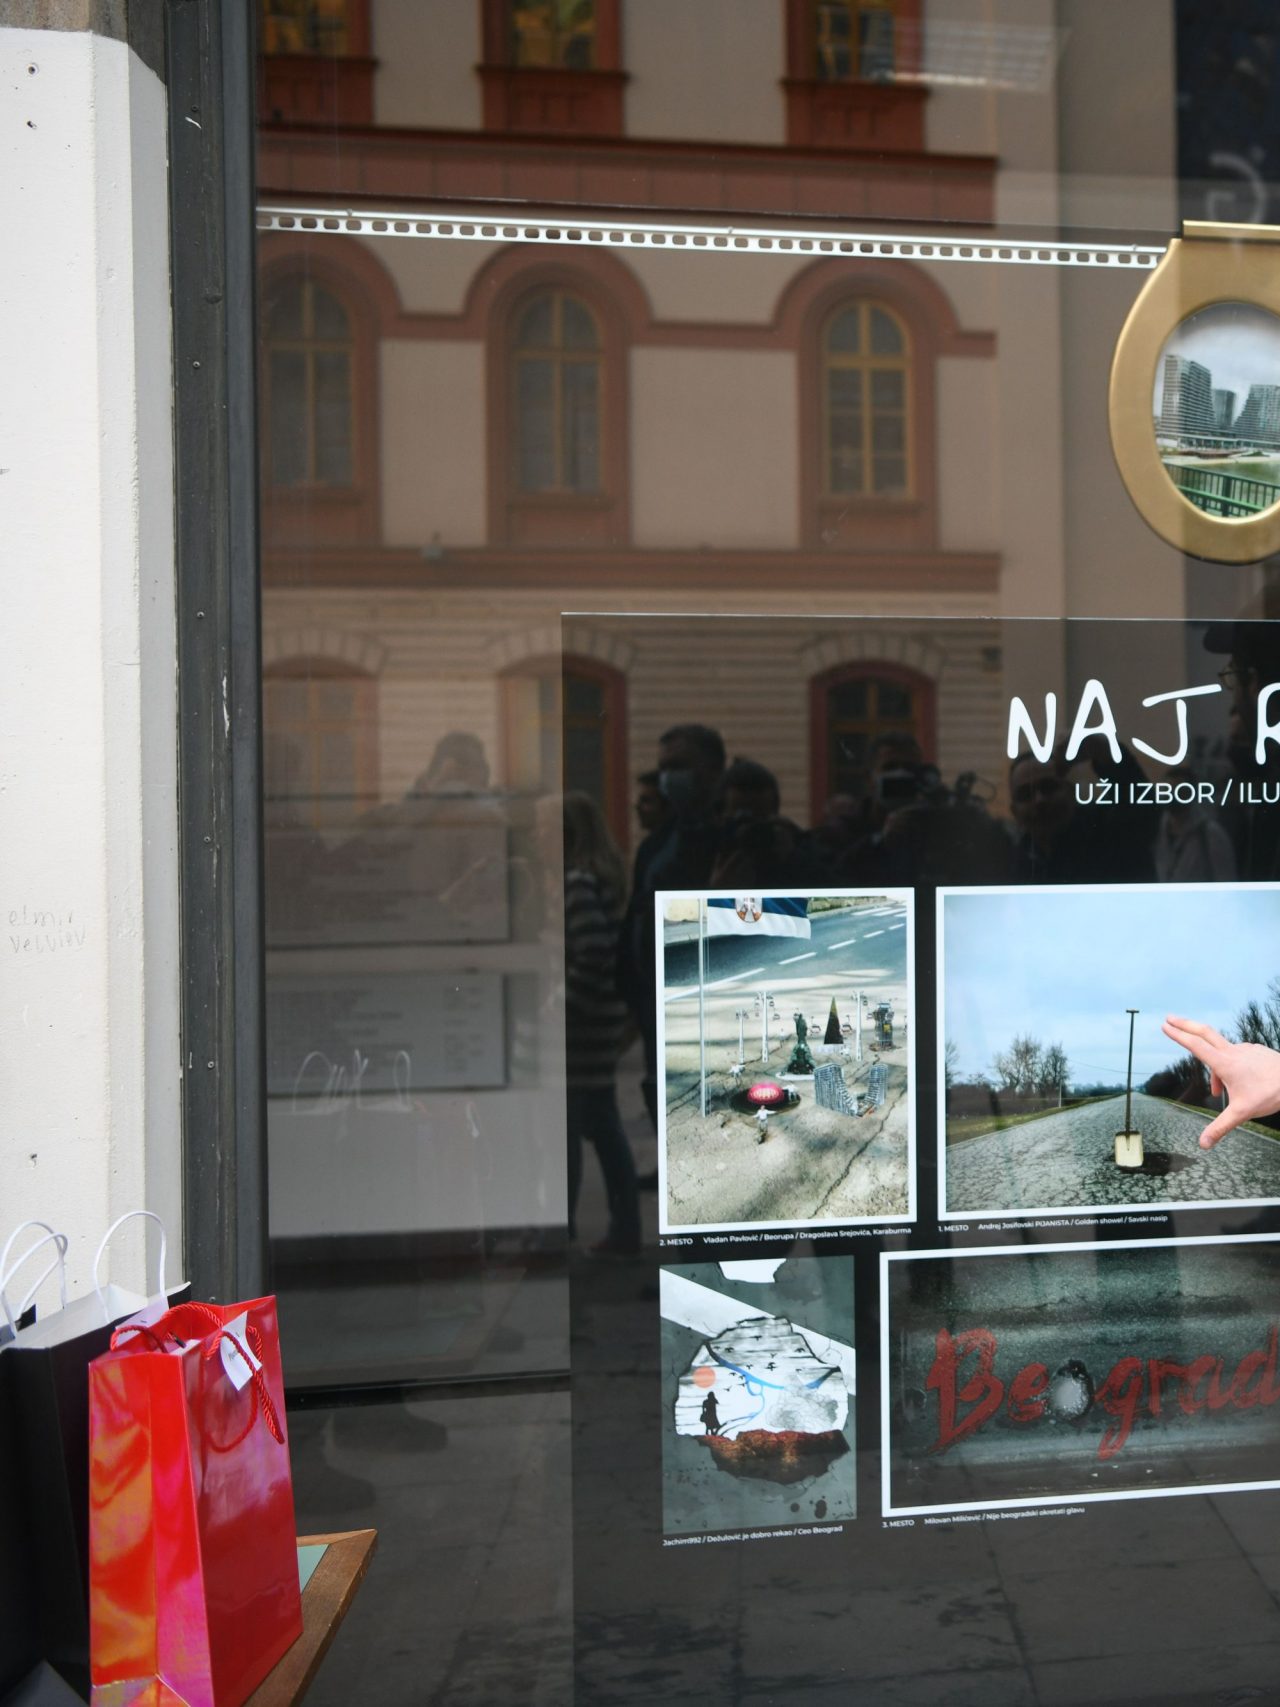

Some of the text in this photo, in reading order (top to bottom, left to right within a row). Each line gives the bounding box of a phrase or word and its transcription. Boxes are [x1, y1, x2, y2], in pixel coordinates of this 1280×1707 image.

[1007, 678, 1223, 766] NAJ
[1075, 778, 1120, 805] UŽI
[1129, 782, 1215, 805] IZBOR
[944, 1224, 970, 1232] MESTO
[978, 1222, 1002, 1231] Andrej
[1002, 1220, 1035, 1230] Josifovski
[1075, 1217, 1099, 1226] Golden
[1128, 1215, 1149, 1223] Savski
[1150, 1214, 1168, 1223] nasip
[667, 1238, 694, 1246] MESTO
[703, 1235, 729, 1244] Vladan
[730, 1234, 759, 1242] Pavlović
[764, 1232, 794, 1241] Beorupa
[800, 1230, 838, 1240] Dragoslava
[812, 1525, 843, 1534] Beograd
[889, 1519, 915, 1528] MESTO
